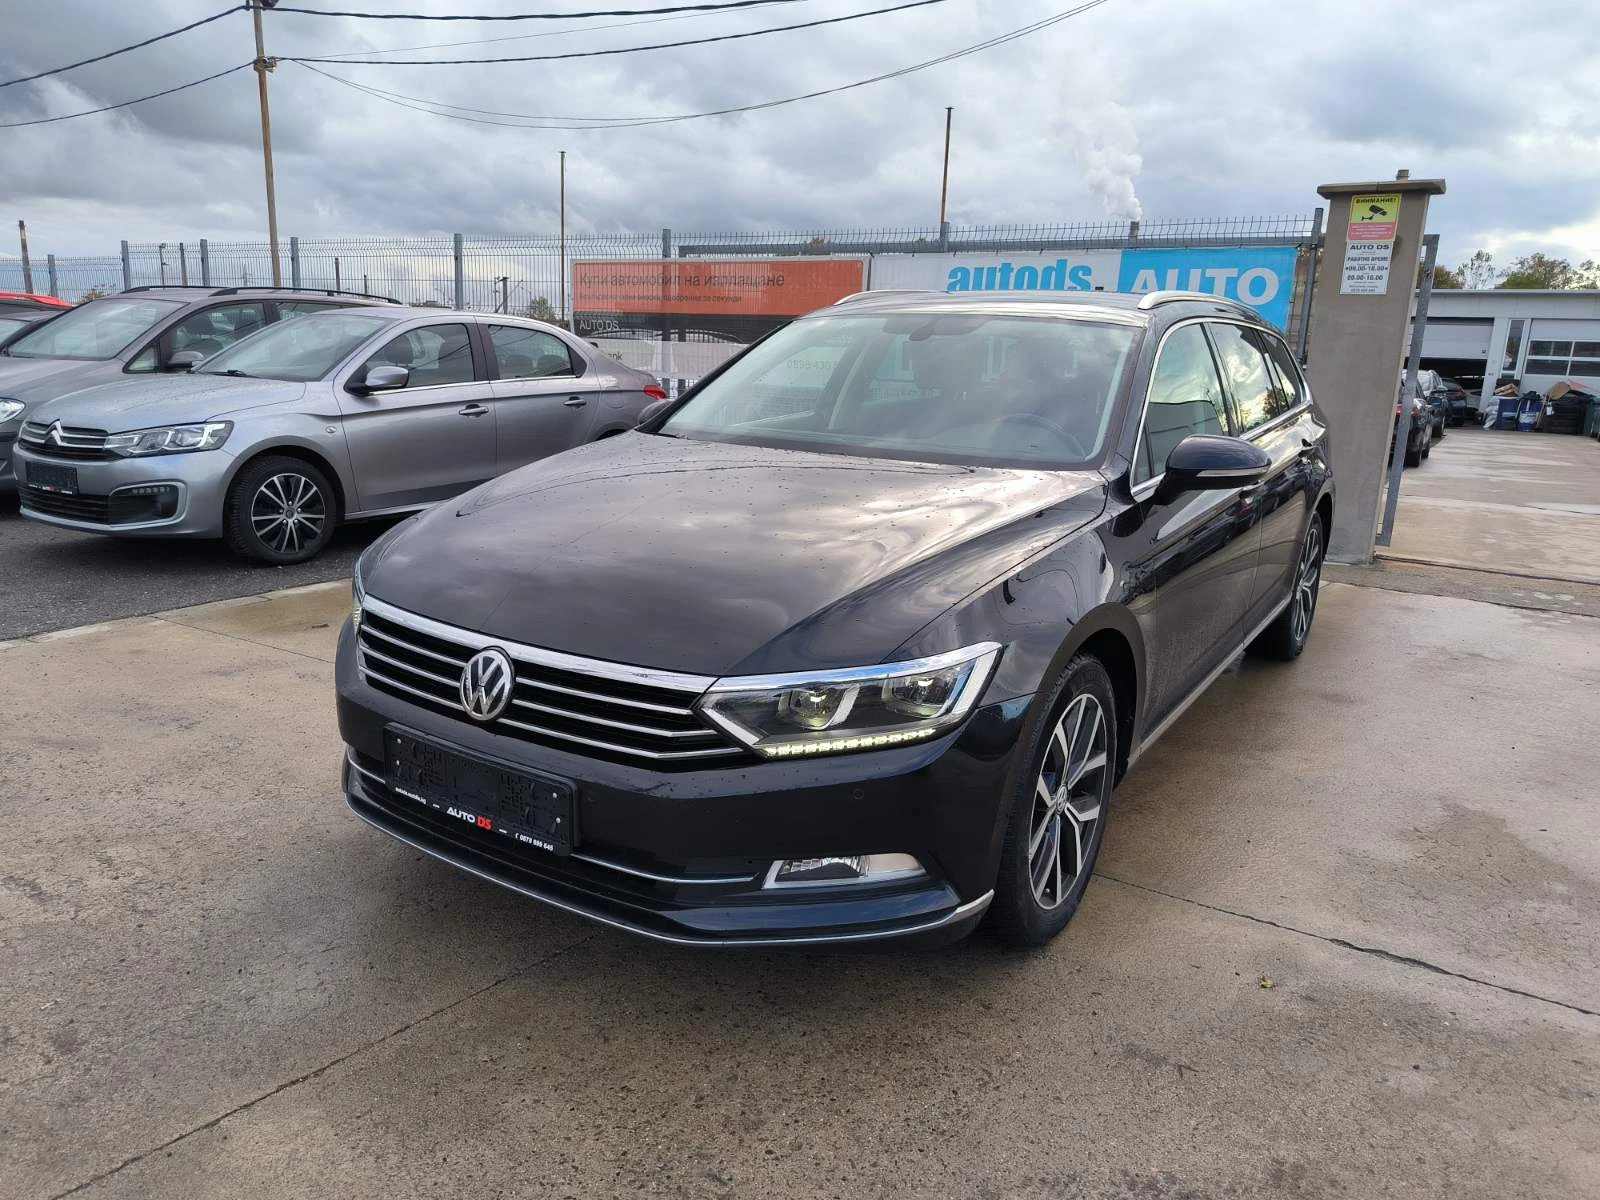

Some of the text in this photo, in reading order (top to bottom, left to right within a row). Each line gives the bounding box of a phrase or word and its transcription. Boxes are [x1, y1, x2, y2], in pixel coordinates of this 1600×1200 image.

[580, 272, 608, 288] Купи
[610, 272, 681, 287] автомобил
[685, 275, 700, 286] на
[1130, 267, 1280, 306] AUTO
[579, 320, 619, 330] AUTO DS
[446, 806, 492, 831] AUTO DS
